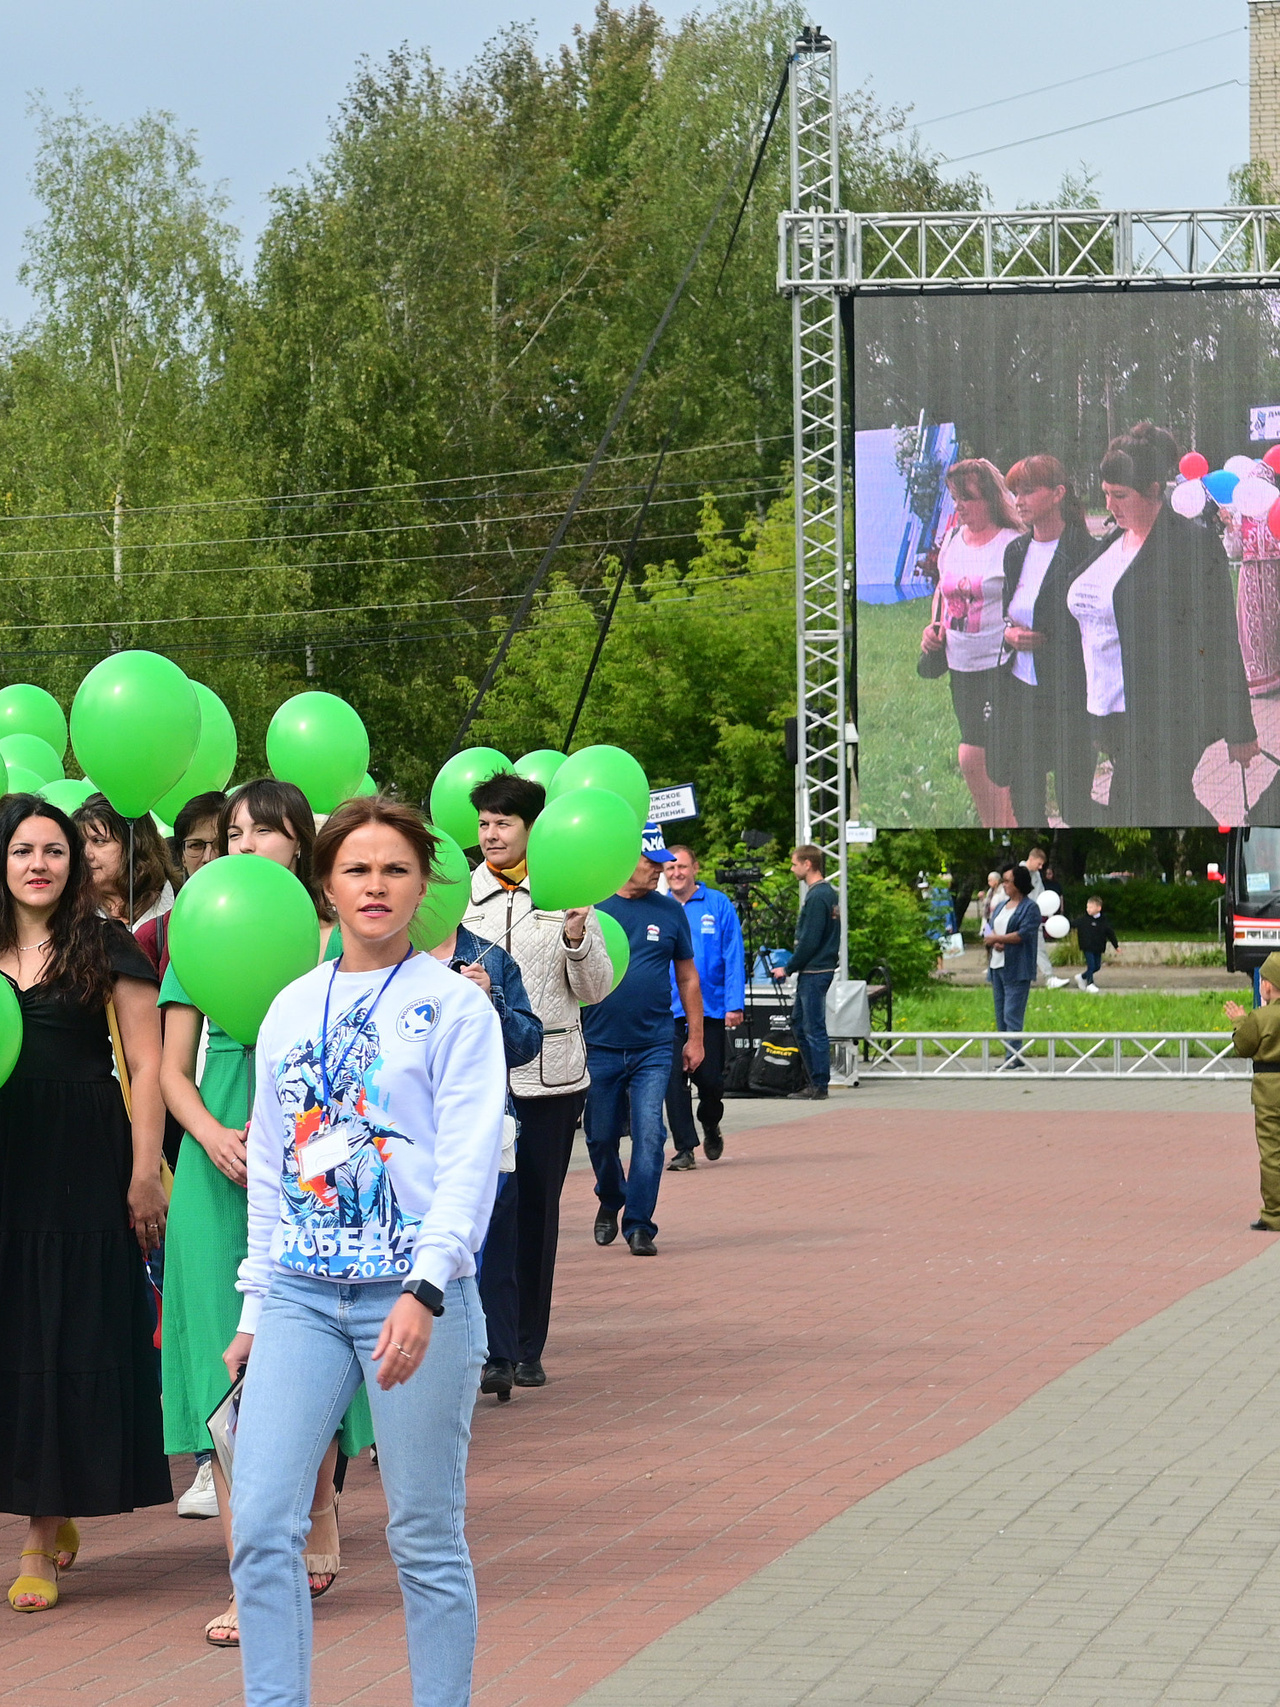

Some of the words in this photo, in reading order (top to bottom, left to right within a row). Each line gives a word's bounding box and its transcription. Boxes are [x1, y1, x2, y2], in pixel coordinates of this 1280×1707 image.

[650, 791, 681, 803] ЛЖСКОЕ
[649, 800, 682, 811] ЛЬСКОЕ
[647, 808, 686, 820] СЕЛЕНИЕ
[282, 1224, 418, 1262] ПОБЕДА
